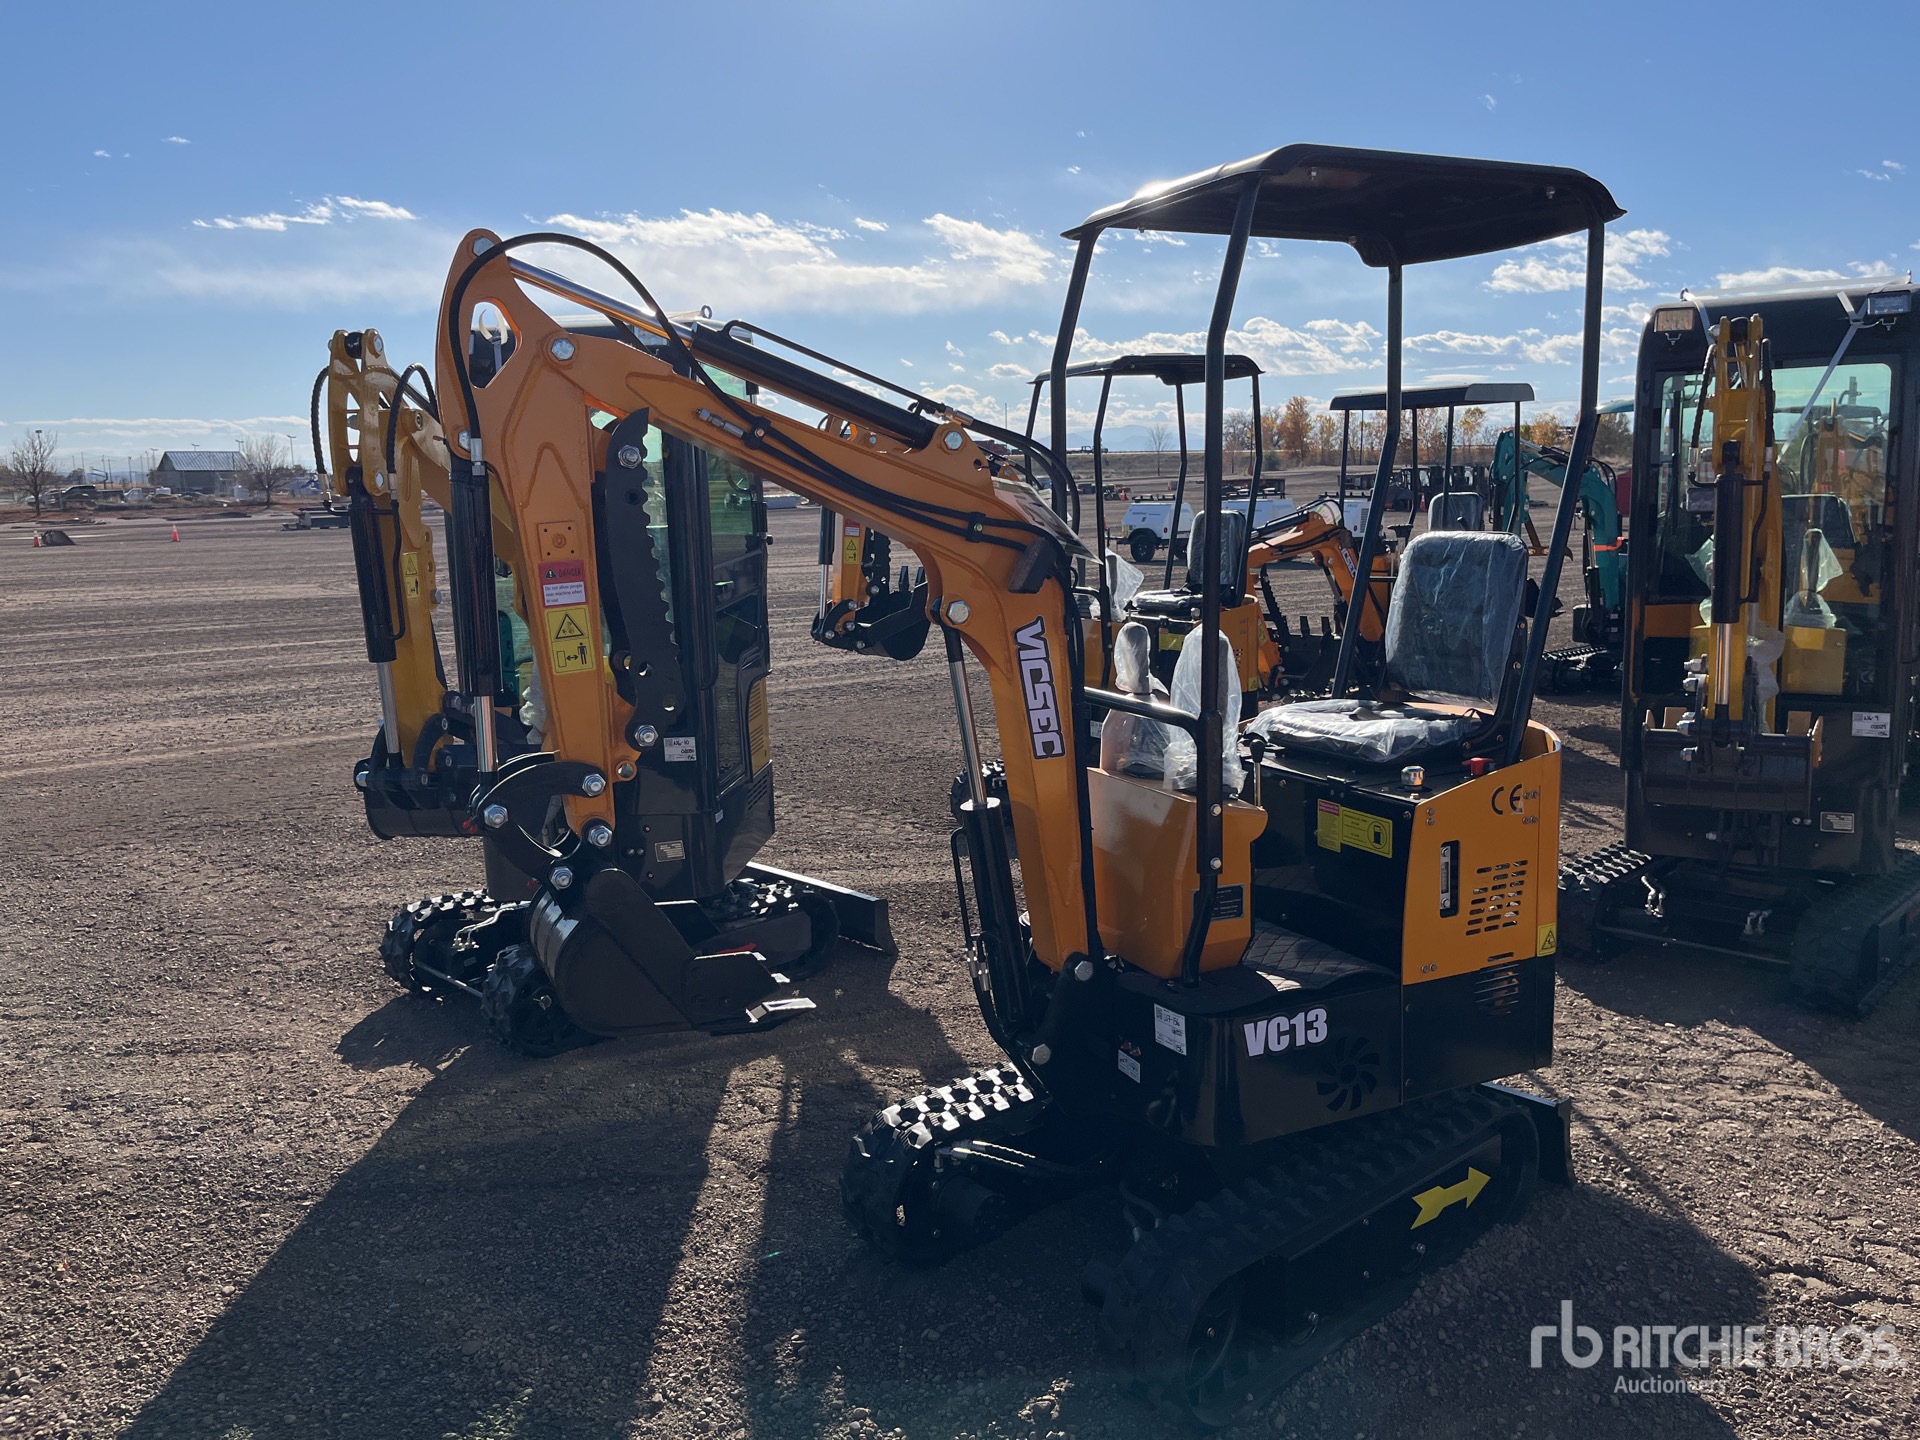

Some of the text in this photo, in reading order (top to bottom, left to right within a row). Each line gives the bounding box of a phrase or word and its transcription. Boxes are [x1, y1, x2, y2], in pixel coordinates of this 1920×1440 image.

[558, 568, 582, 577] DANGER
[1015, 617, 1064, 758] VICSEC
[1491, 784, 1523, 815] CE
[1243, 1008, 1328, 1057] VC13
